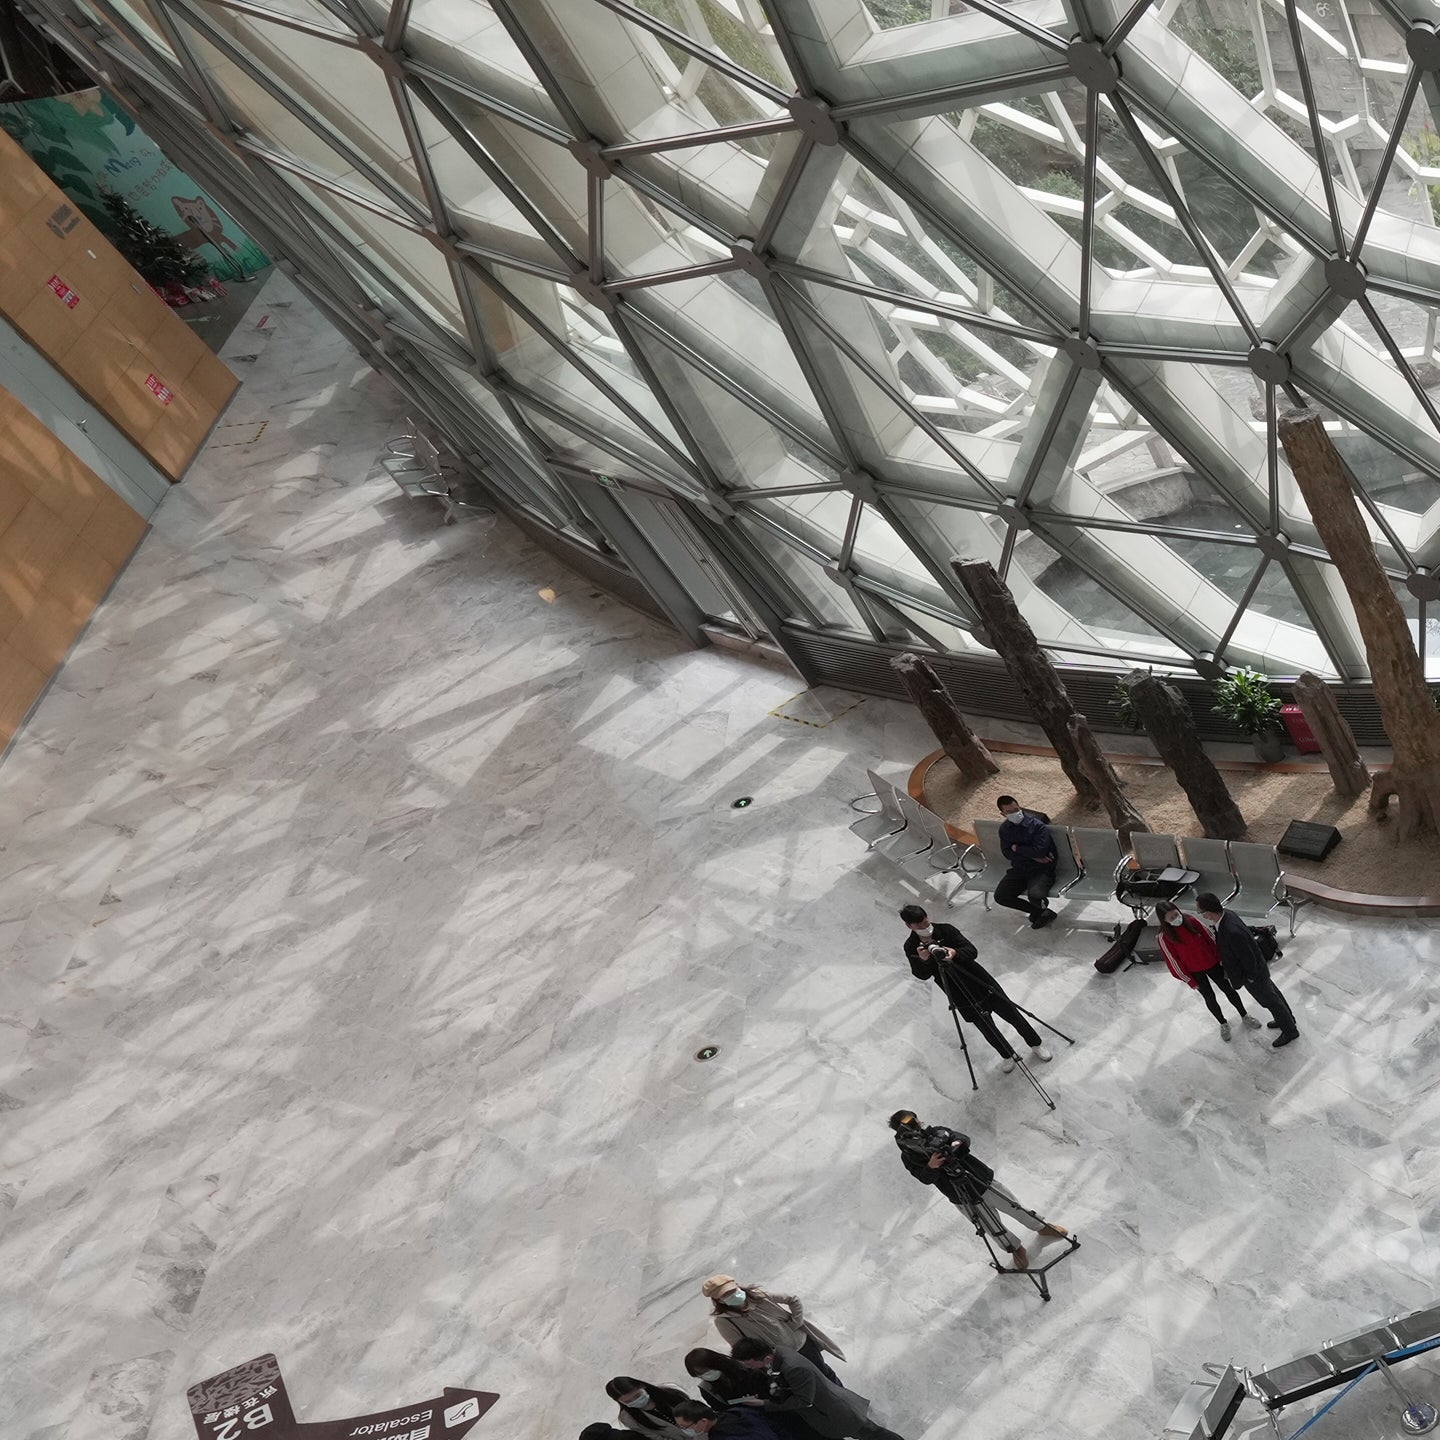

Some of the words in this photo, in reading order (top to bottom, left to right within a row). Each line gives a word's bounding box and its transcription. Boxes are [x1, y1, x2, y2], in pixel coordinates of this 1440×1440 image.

[203, 1385, 278, 1424] 所在楼层
[349, 1409, 433, 1437] Escalator
